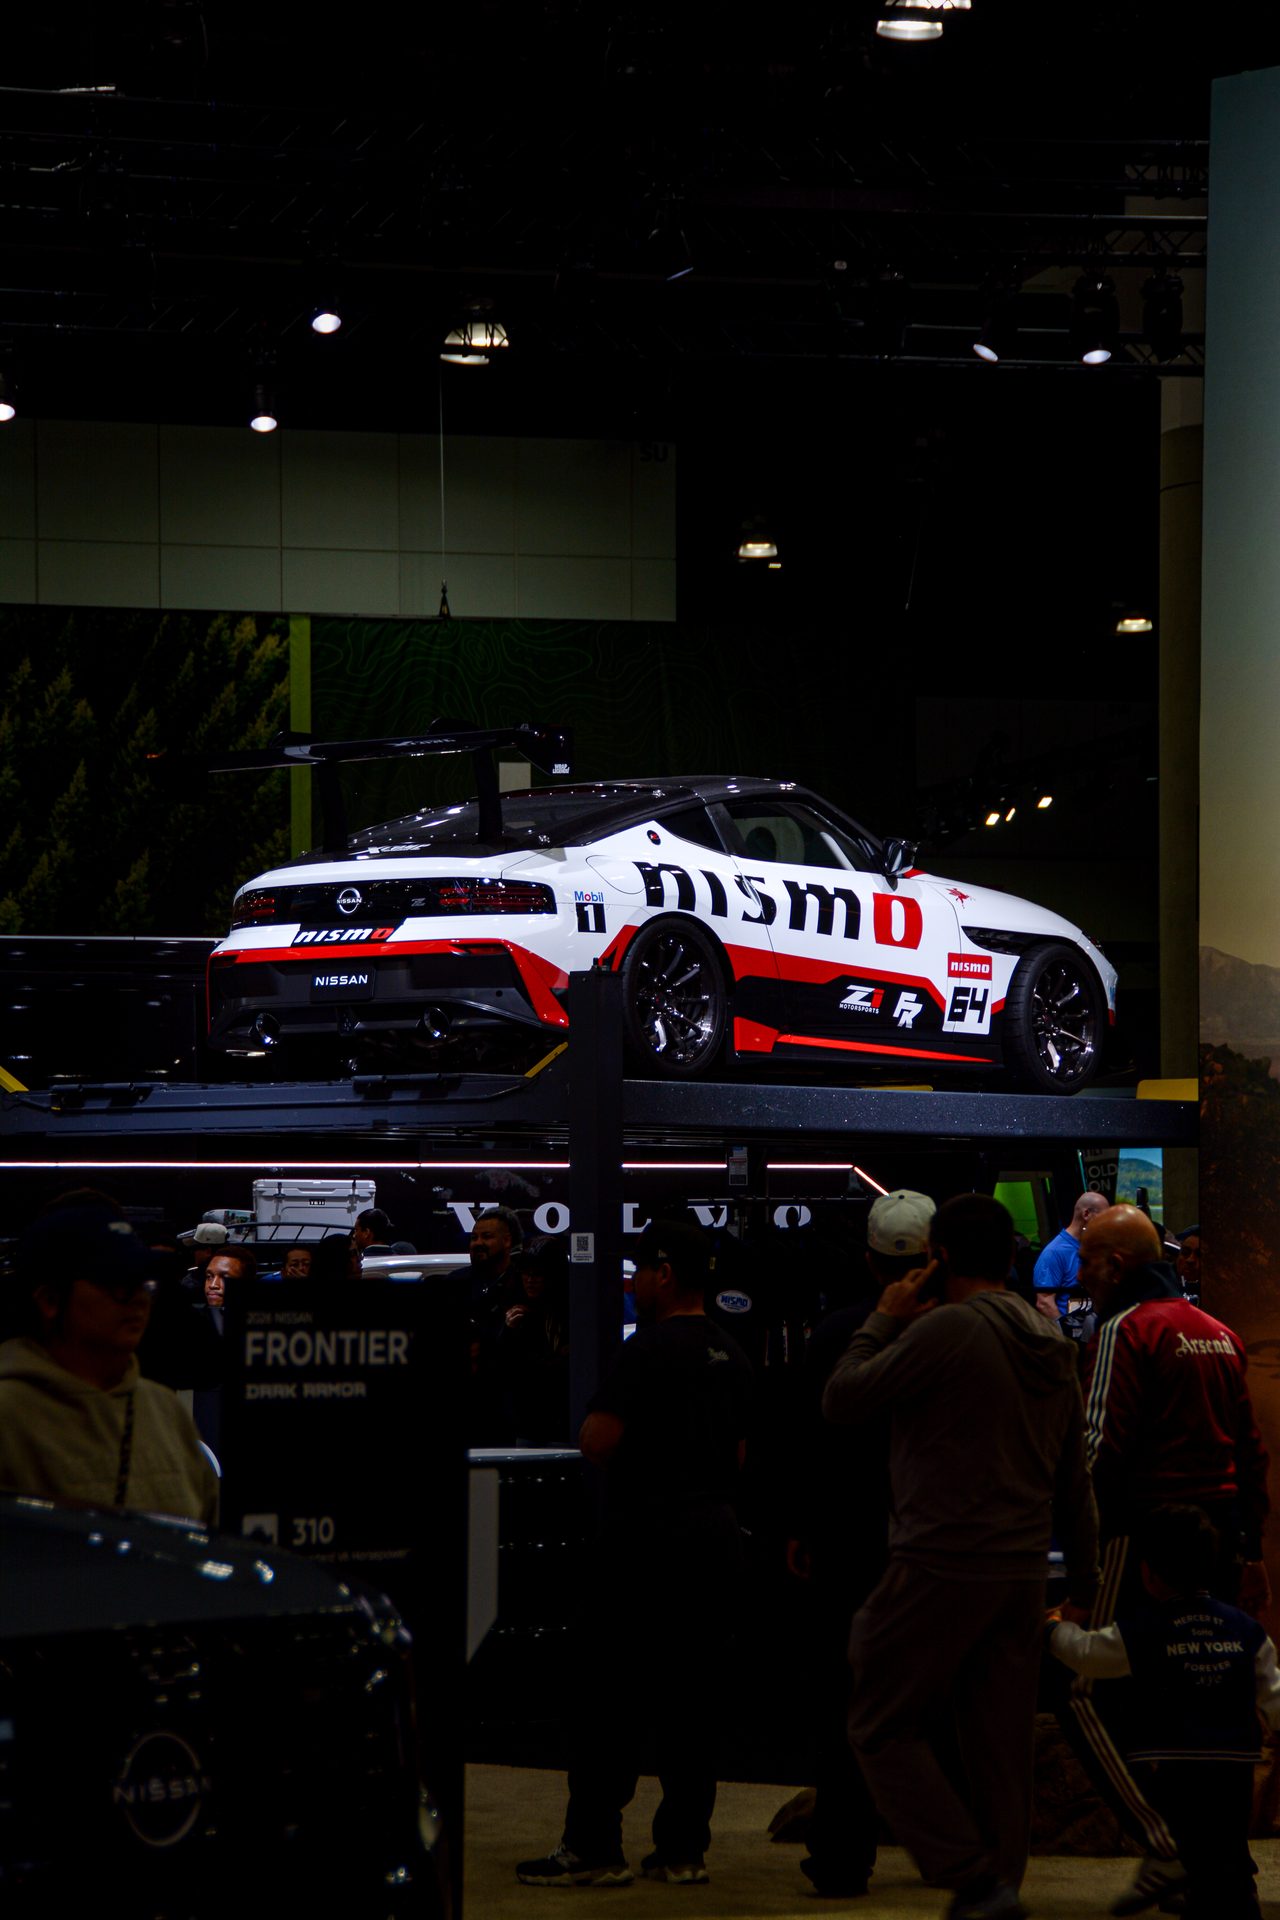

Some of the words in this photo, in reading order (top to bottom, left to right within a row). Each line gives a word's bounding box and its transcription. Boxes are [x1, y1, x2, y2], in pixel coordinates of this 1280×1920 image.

[336, 897, 362, 905] NISSAN
[574, 891, 604, 902] Mobil
[315, 974, 368, 986] NISSAN
[838, 1002, 880, 1015] MOTORSPORTS
[947, 986, 989, 1024] 64
[244, 1330, 410, 1368] FRONTIER
[1176, 1332, 1236, 1357] Arsenal
[245, 1382, 298, 1400] DARK
[302, 1380, 368, 1399] ARMOR
[291, 1515, 336, 1547] 310
[1173, 1614, 1211, 1628] MERCER
[1167, 1641, 1201, 1657] NEW
[1203, 1640, 1244, 1654] YORK
[1184, 1660, 1232, 1672] FOREVER
